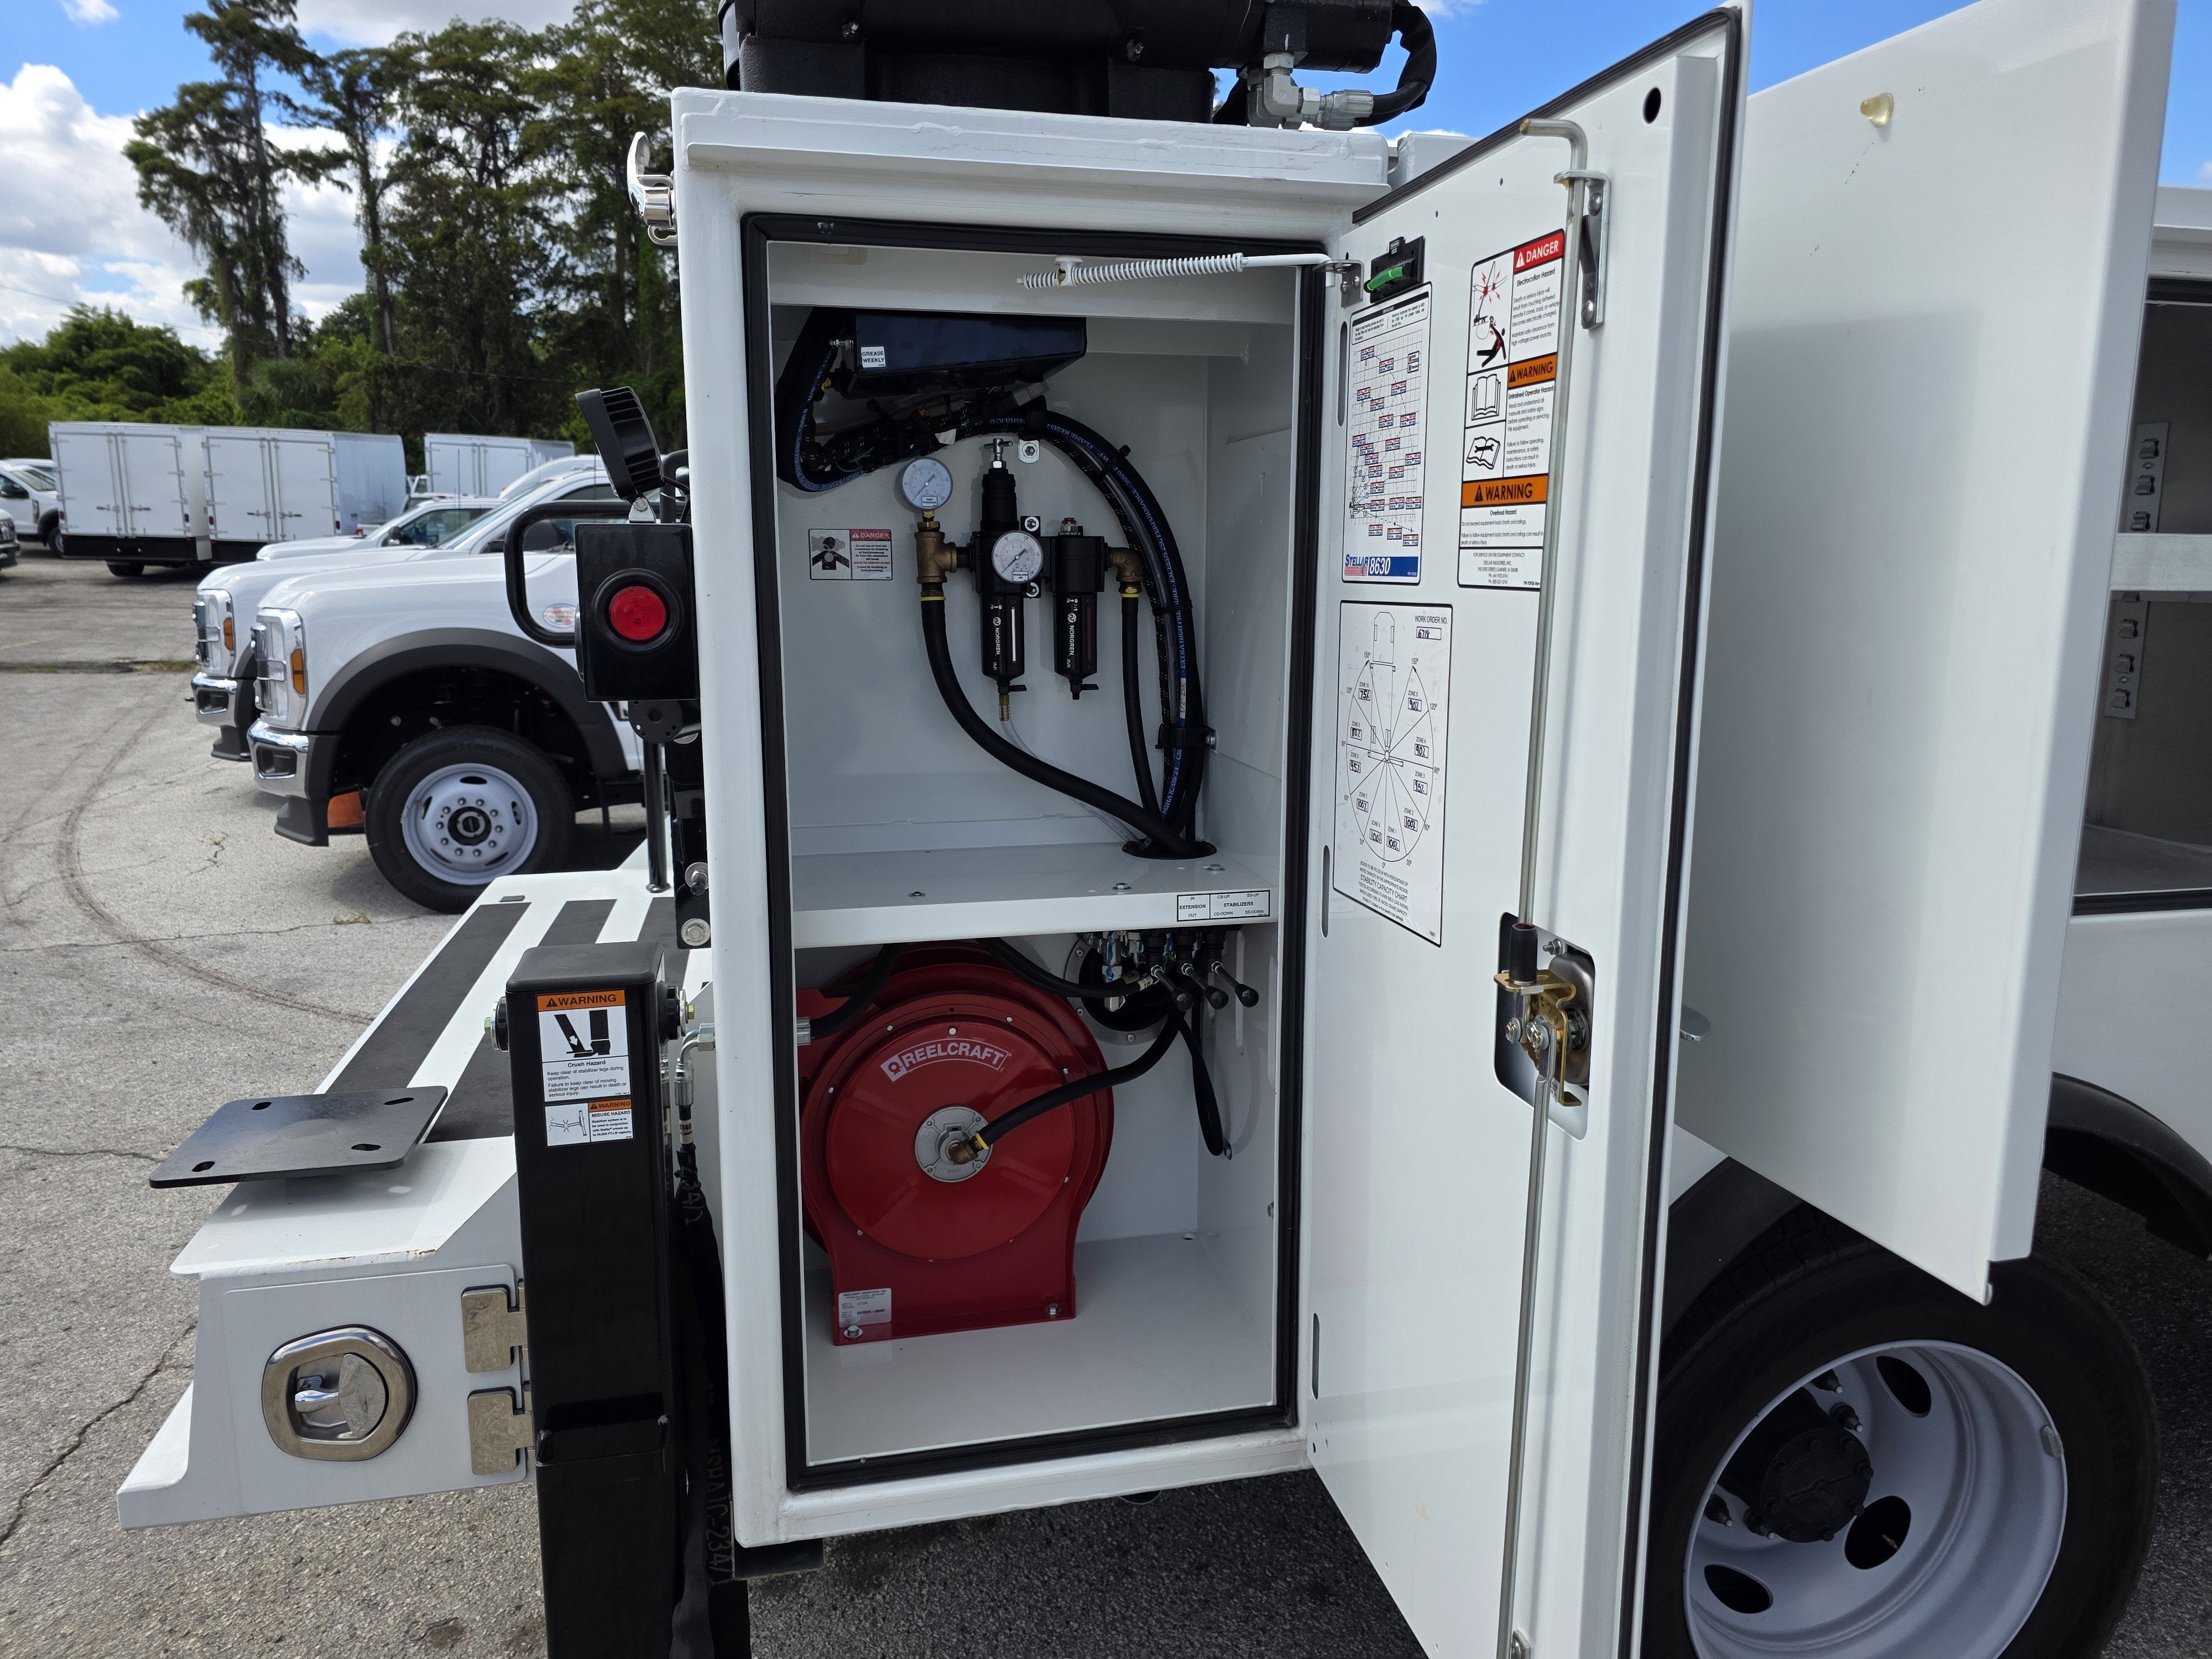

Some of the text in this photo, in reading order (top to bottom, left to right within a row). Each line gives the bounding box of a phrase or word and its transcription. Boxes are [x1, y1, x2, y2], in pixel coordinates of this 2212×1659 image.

[1526, 241, 1558, 263] DANGER
[1517, 268, 1555, 286] Electrocution Hazard
[1542, 294, 1556, 302] tethered
[1531, 325, 1547, 333] clearance
[1517, 362, 1553, 380] WARNING
[1508, 384, 1554, 399] Untrained Operator Hazard
[1485, 483, 1532, 501] WARNING
[1132, 489, 1161, 538] PERFORMANCE
[1162, 552, 1175, 583] EXCEEDS
[1345, 554, 1391, 575] STELLAR 8630
[1360, 874, 1407, 902] STABILITY CAPACITY CHART
[558, 994, 616, 1006] WARNING
[901, 1042, 1004, 1067] REELCRAFT
